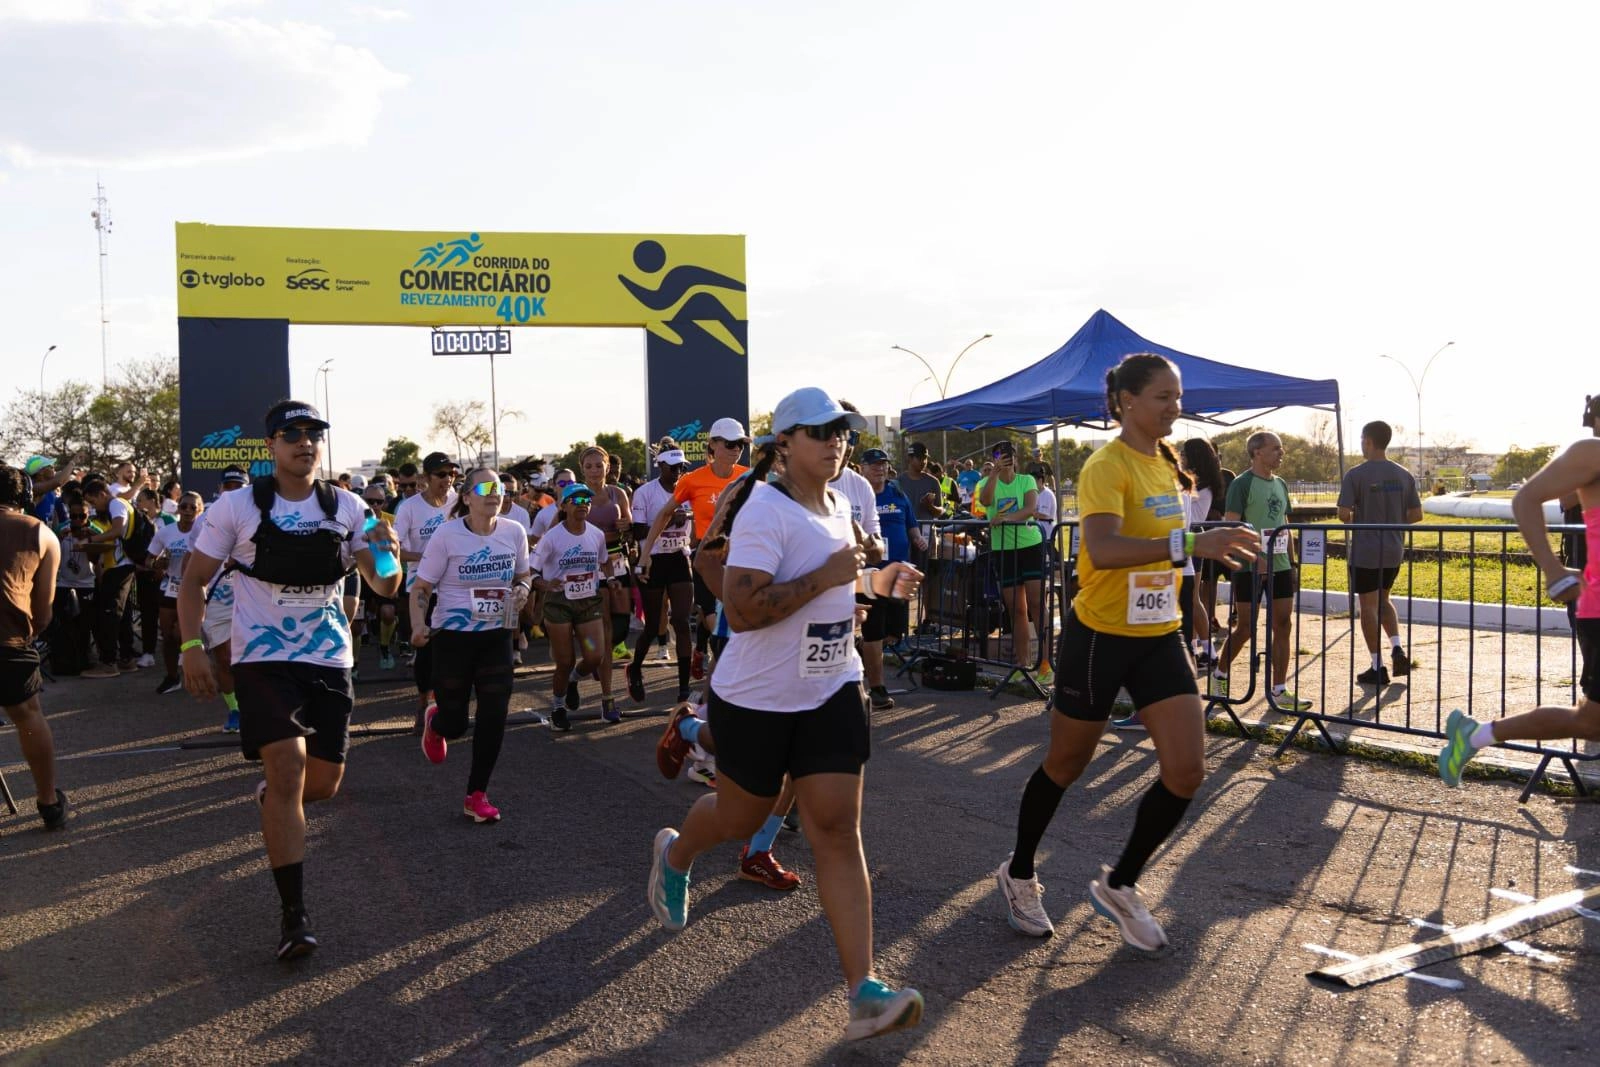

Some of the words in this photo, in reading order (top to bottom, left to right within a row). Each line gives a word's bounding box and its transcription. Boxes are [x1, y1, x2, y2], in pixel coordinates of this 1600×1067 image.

[473, 256, 530, 270] CORRIDA
[532, 258, 550, 271] DO
[202, 272, 265, 289] tvglobo
[400, 269, 551, 294] COMERCIÁRIO
[400, 292, 497, 308] REVEZAMENTO
[496, 295, 547, 323] 40K
[432, 331, 510, 353] 00:00:03
[250, 461, 276, 478] 40
[662, 536, 686, 548] 211-1
[501, 569, 513, 582] 40
[568, 582, 592, 593] 437-1
[477, 601, 504, 613] 273-
[806, 640, 848, 662] 257-1
